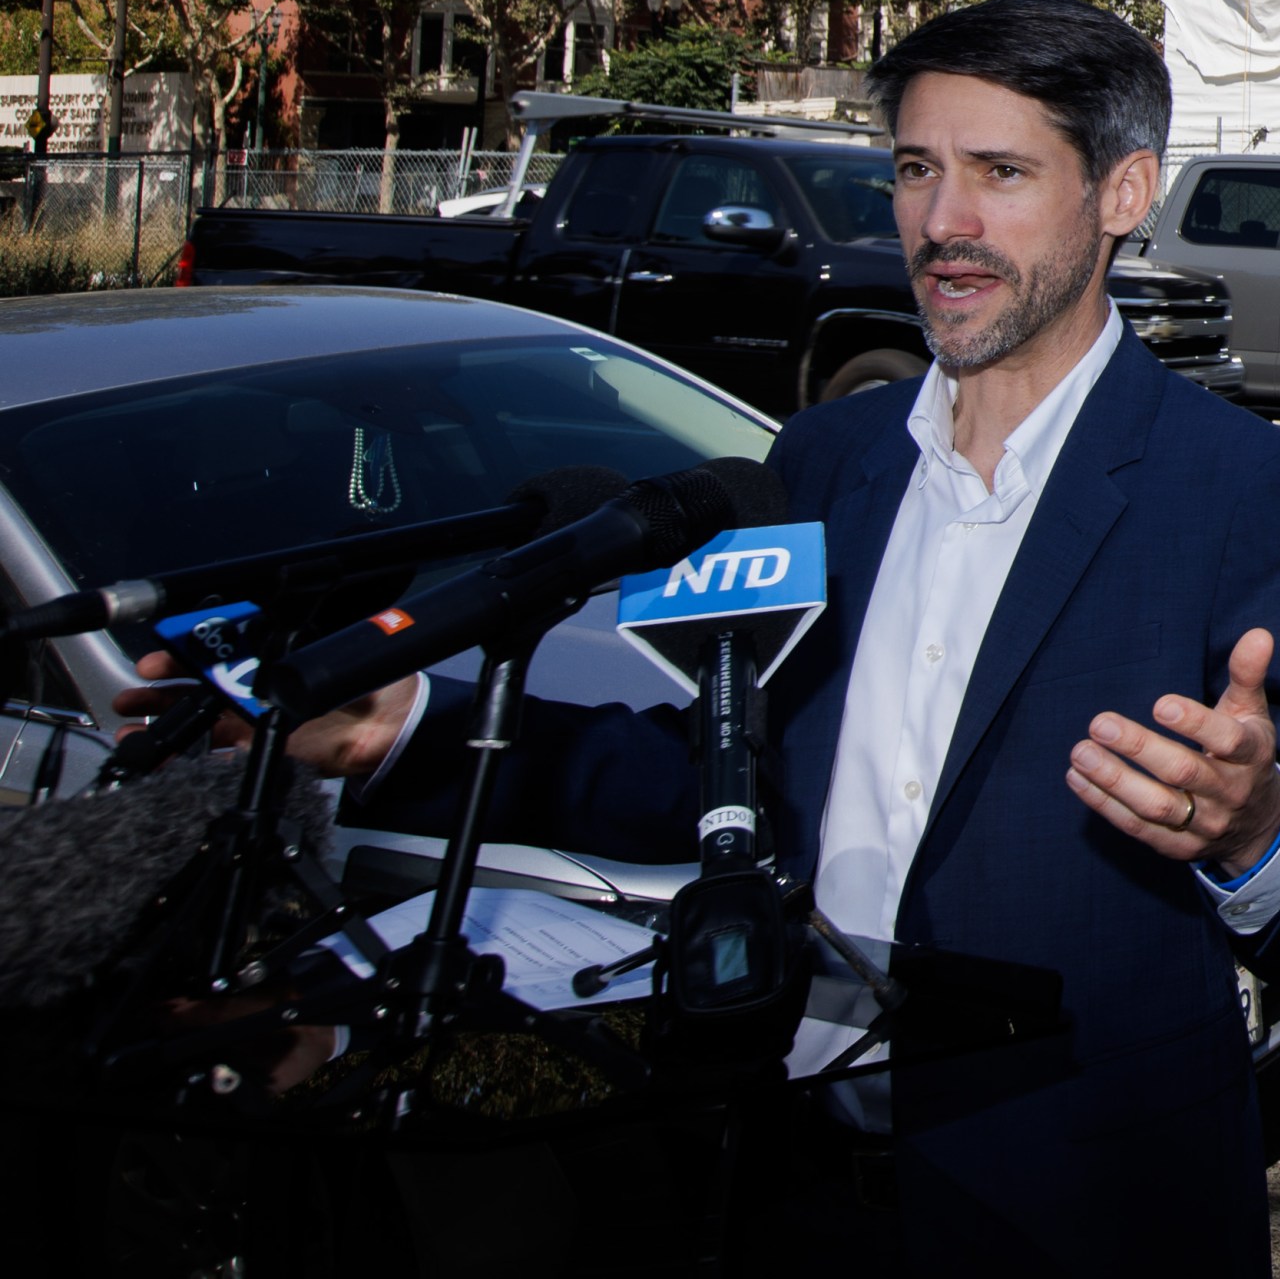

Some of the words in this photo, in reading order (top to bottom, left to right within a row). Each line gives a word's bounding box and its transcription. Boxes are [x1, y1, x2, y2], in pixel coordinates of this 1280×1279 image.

[49, 93, 81, 106] COURT
[82, 93, 95, 106] OF
[56, 108, 68, 121] OF
[663, 547, 791, 598] NTD
[192, 622, 235, 658] abc
[720, 640, 732, 716] SENNHEISER
